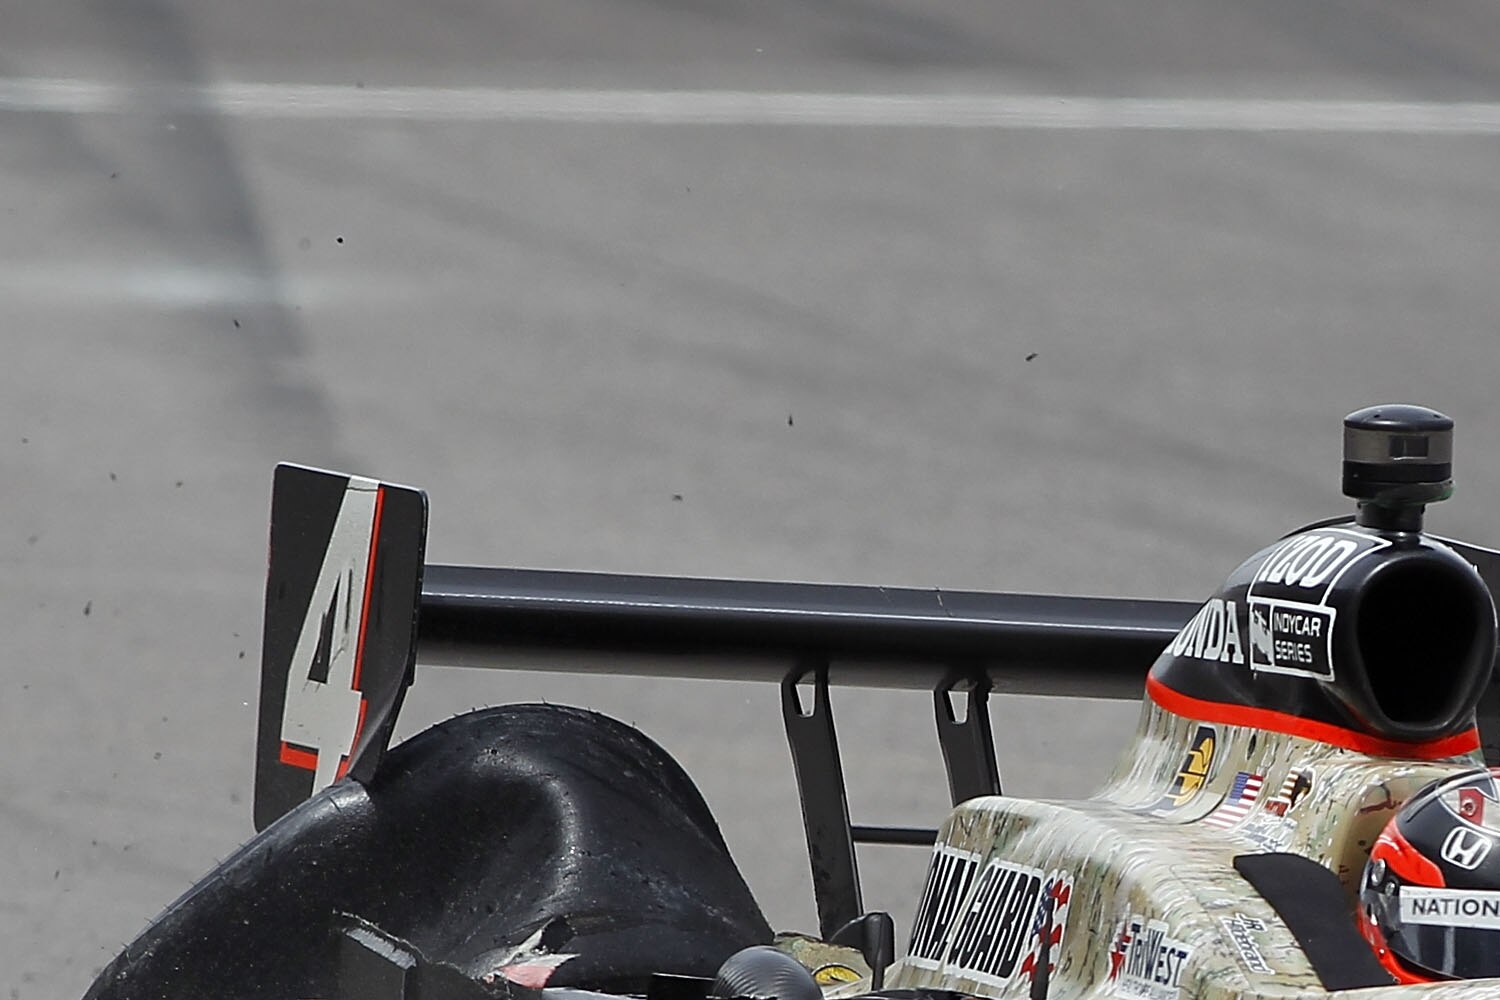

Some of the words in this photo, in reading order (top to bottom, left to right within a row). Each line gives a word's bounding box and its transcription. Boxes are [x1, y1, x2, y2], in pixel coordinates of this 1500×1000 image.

[1257, 534, 1359, 588] IZOD
[281, 475, 384, 798] 4
[1163, 598, 1245, 665] ONDA
[1273, 611, 1321, 638] INDYCAR
[1273, 639, 1314, 664] SERIES
[945, 861, 1043, 981] GUARD
